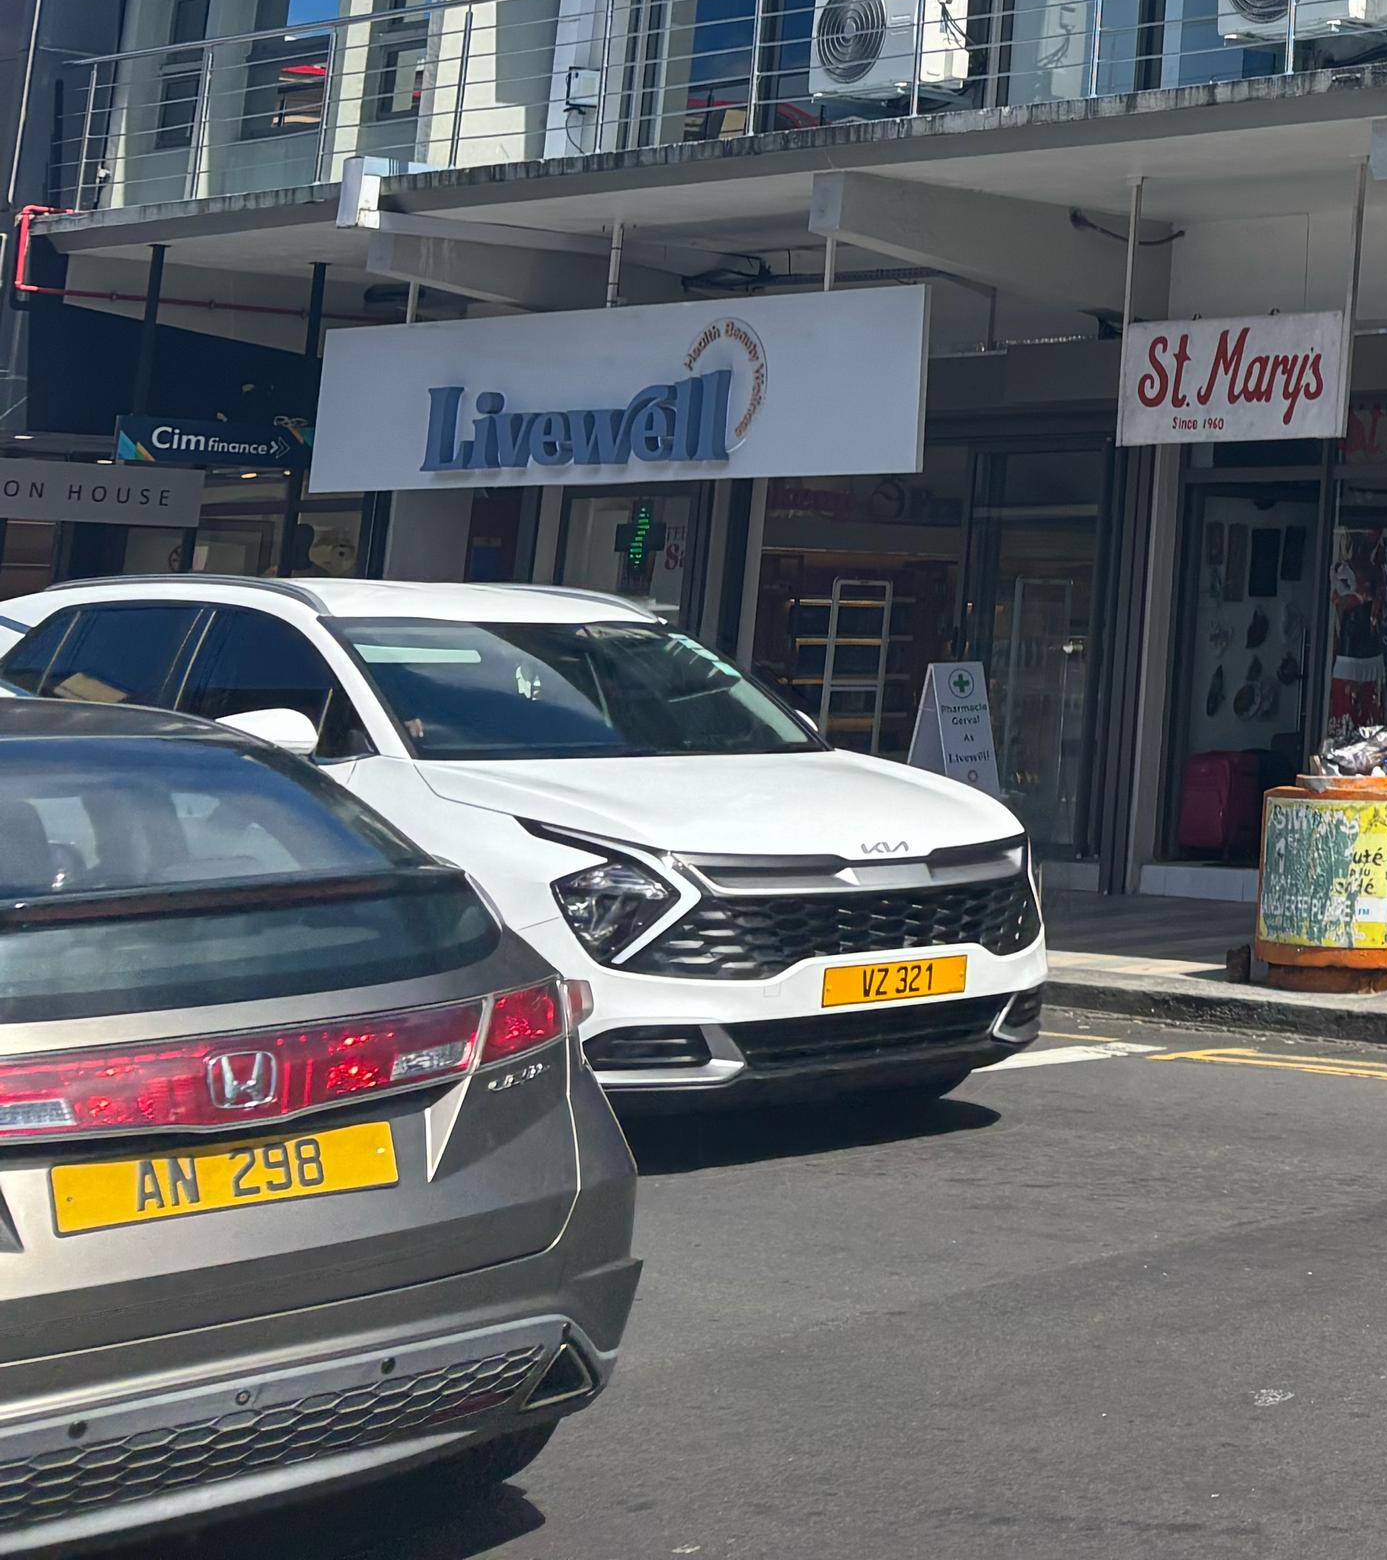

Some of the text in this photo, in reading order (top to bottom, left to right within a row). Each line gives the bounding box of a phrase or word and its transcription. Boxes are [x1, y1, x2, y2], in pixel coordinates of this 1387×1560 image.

[1196, 327, 1324, 425] Mary's
[420, 368, 732, 472] Livewell
[1172, 416, 1225, 431] Since 1960
[151, 426, 269, 455] Cim finance
[4, 479, 171, 507] ON HOUSE
[940, 703, 988, 714] Pharmacie
[863, 962, 934, 997] VZ 321
[136, 1138, 324, 1212] AN 298
